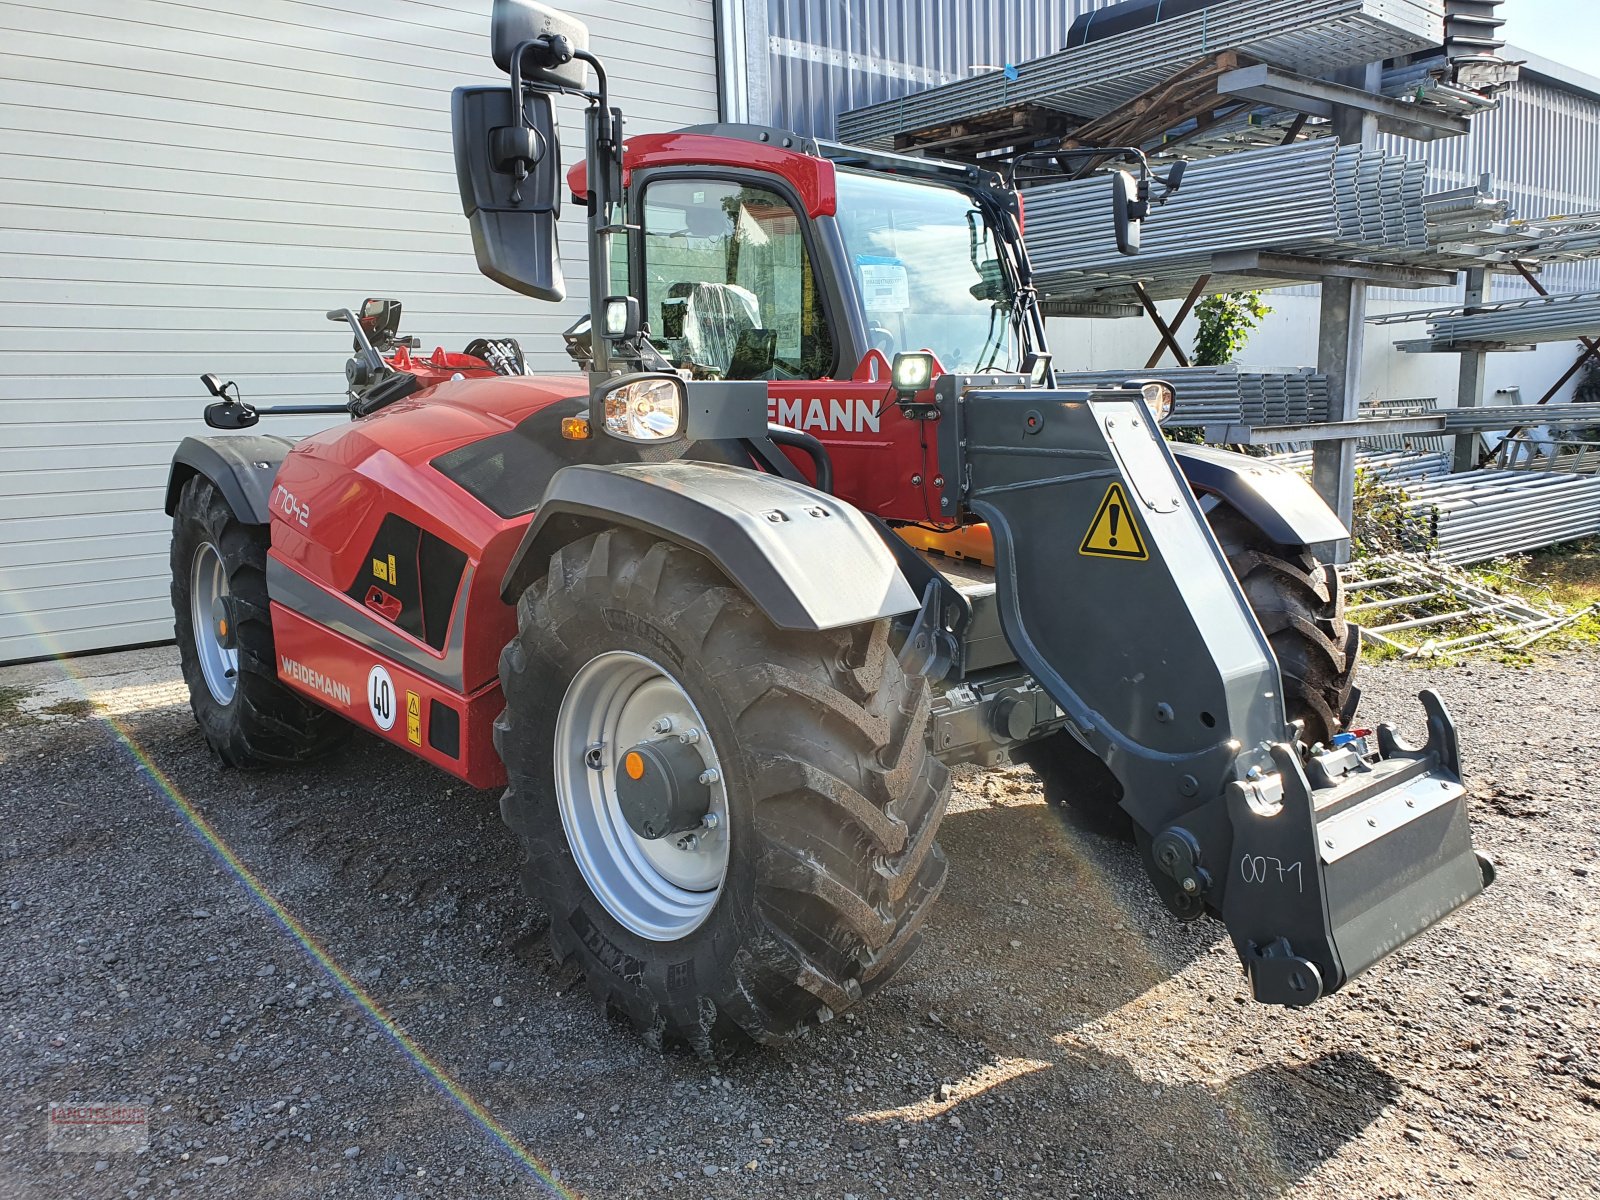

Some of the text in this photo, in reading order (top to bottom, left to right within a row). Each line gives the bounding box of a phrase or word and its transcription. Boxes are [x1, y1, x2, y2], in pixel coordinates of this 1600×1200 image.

[274, 484, 310, 528] T7042
[281, 655, 351, 706] WEIDEMANN
[374, 676, 390, 720] 40
[1240, 853, 1303, 893] 0071
